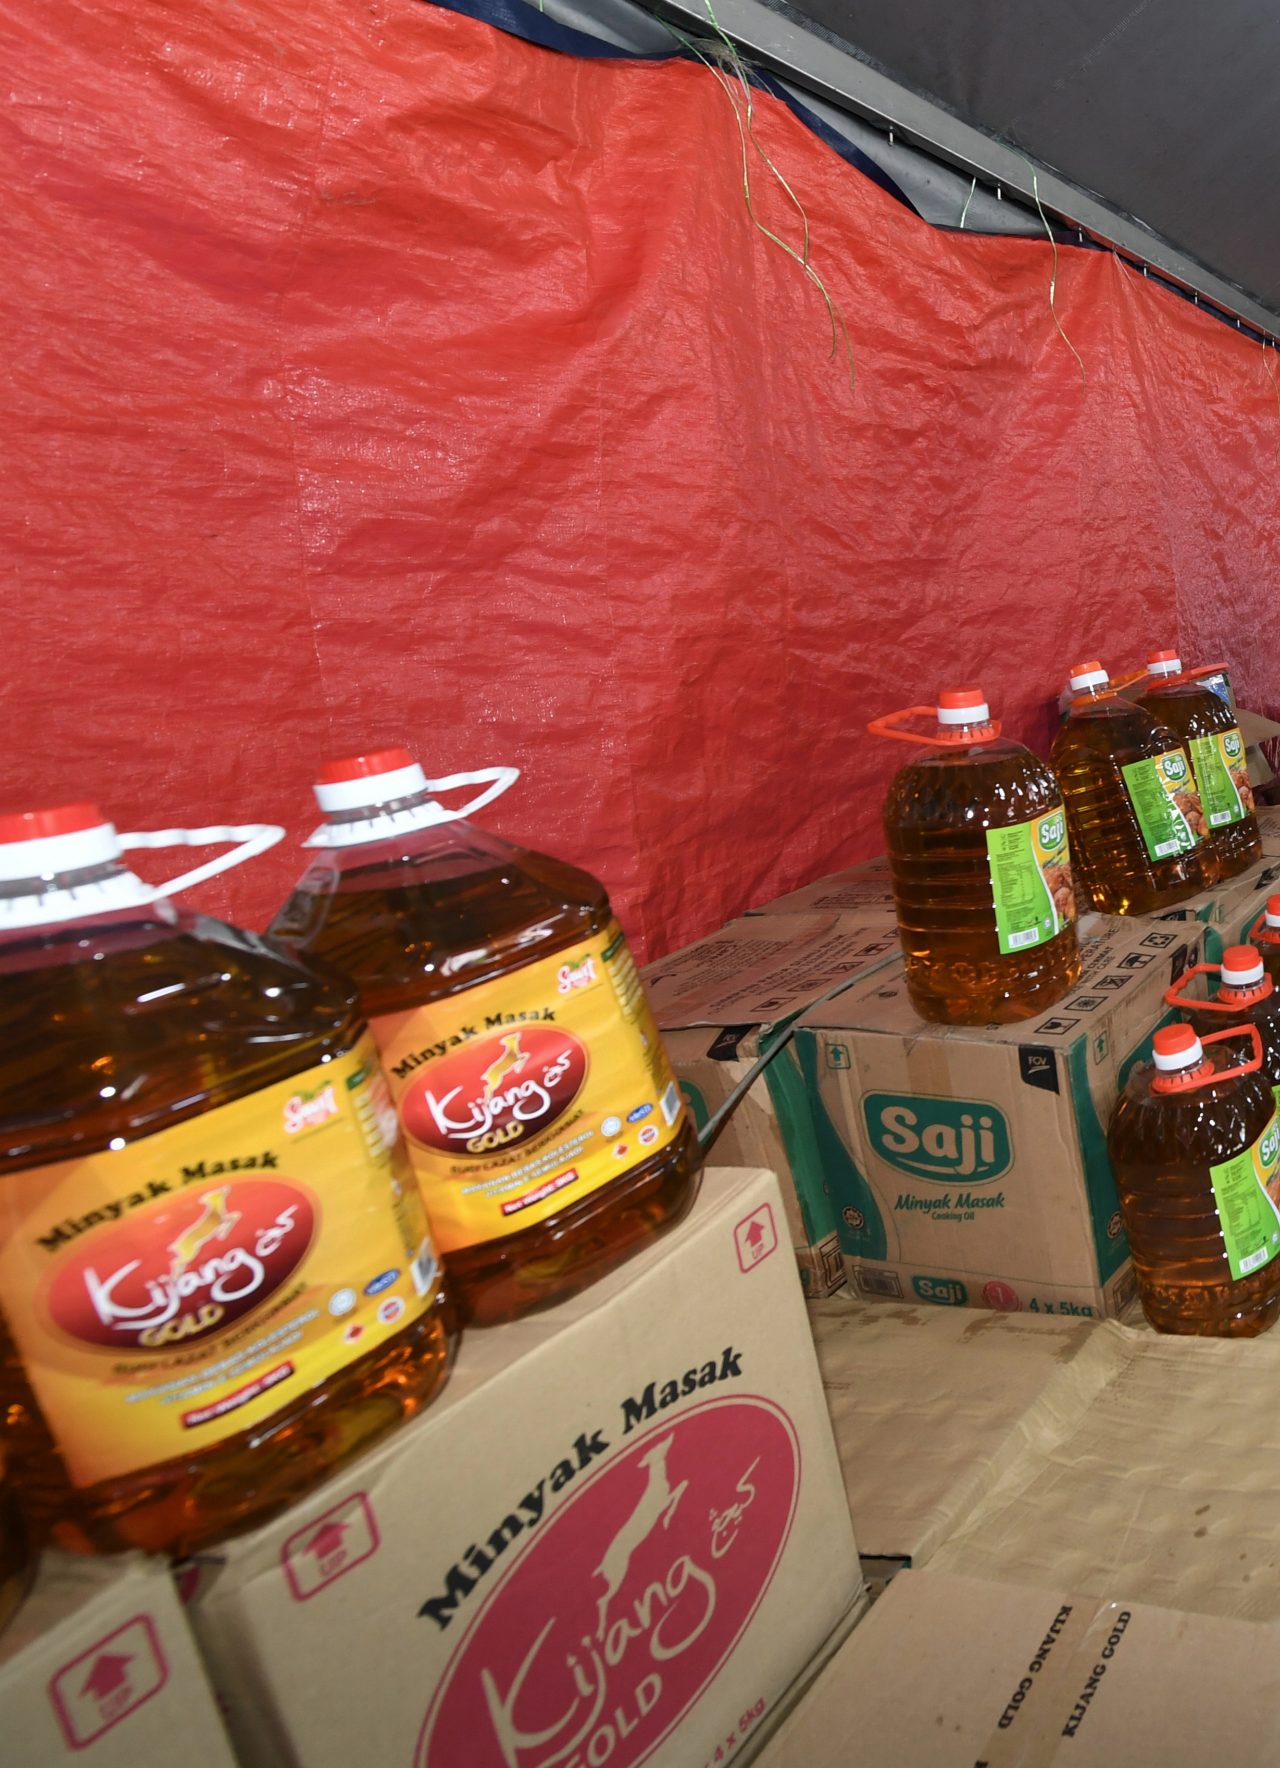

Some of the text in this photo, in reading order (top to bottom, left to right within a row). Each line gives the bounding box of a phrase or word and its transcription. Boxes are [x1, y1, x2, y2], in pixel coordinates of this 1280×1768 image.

[1163, 758, 1185, 777] Saji
[1041, 816, 1064, 844] Saji
[391, 1007, 556, 1079] Minyak Masak
[425, 1079, 551, 1139] Kijang
[466, 1121, 524, 1153] GOLD
[880, 1106, 995, 1176] Saji
[1261, 1122, 1280, 1161] Saji
[36, 1151, 279, 1252] Minyak Masak
[894, 1192, 1005, 1214] Minyak Masak
[931, 1211, 975, 1222] Cooking Oil
[752, 1243, 764, 1260] UP
[82, 1246, 266, 1331] Kijang
[918, 1279, 962, 1302] Saji
[1029, 1298, 1038, 1313] 4
[138, 1301, 226, 1347] GOLD
[416, 1346, 743, 1632] Minyak Masak
[481, 1555, 716, 1768] Kijang
[998, 1605, 1074, 1730] KIJANG GOLD
[1061, 1611, 1132, 1738] KIJANG GOLD
